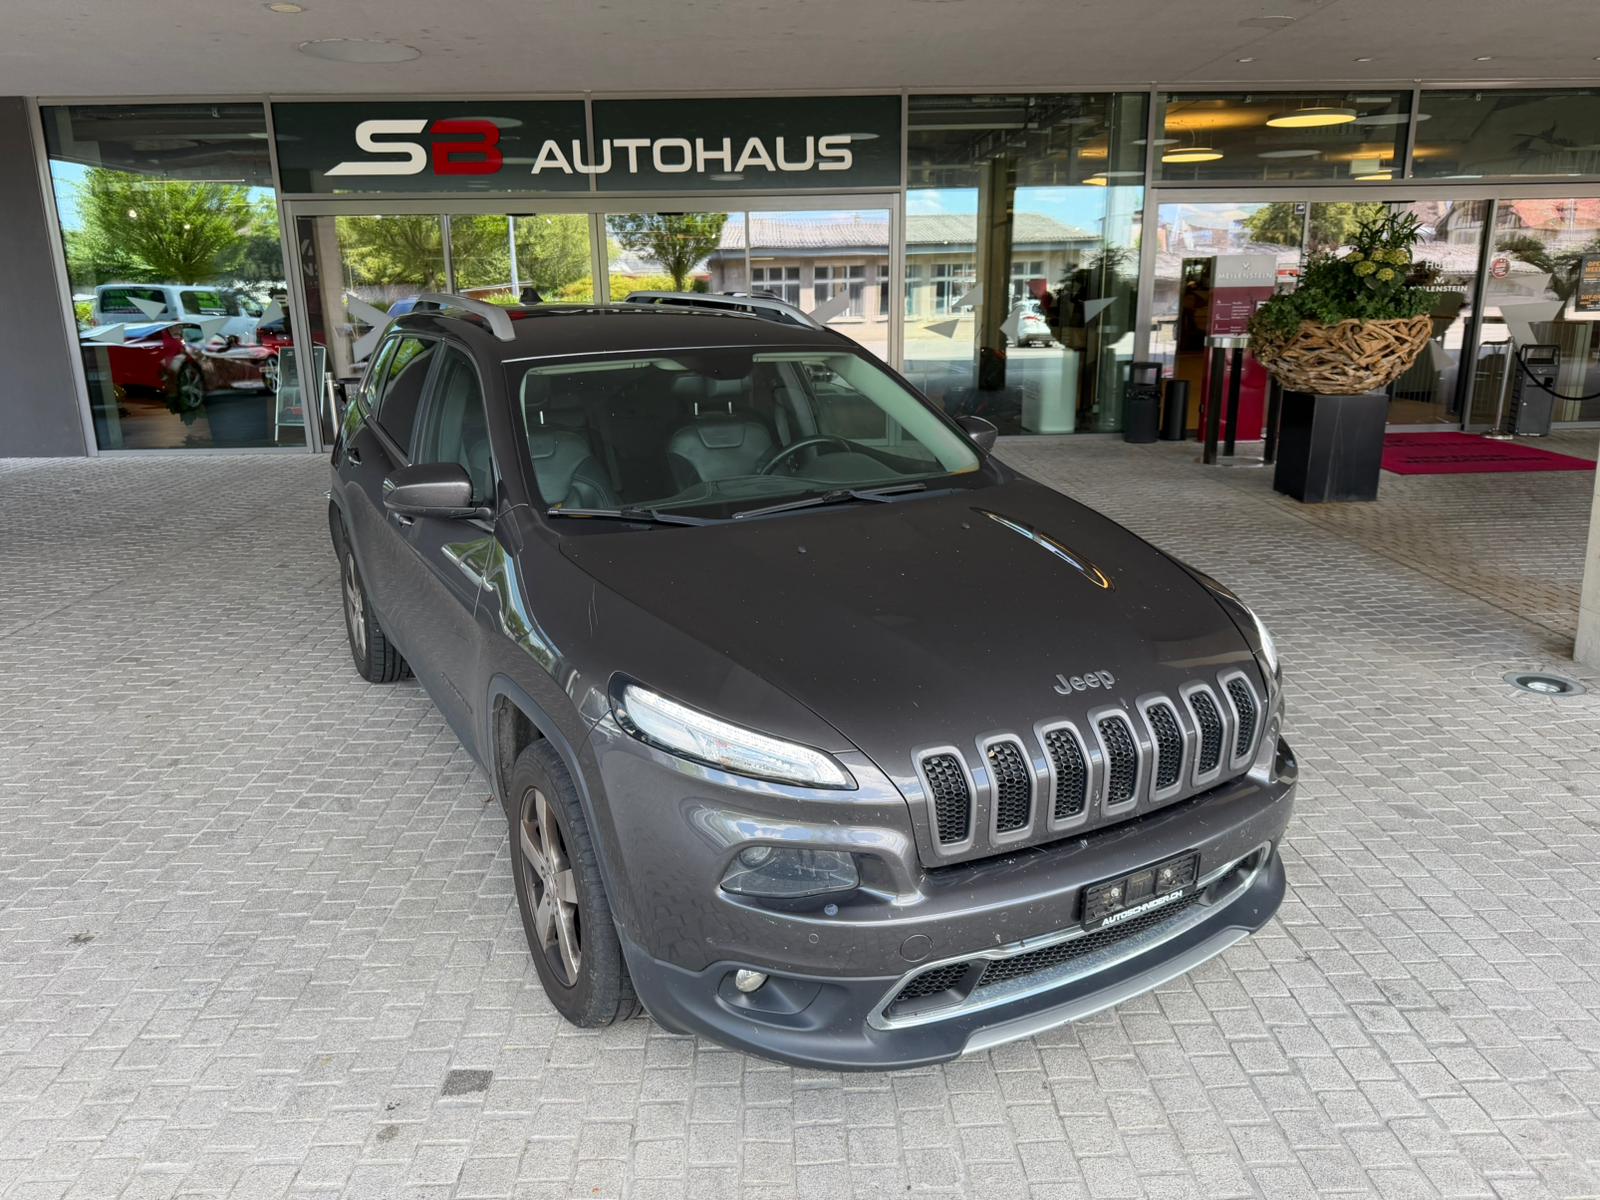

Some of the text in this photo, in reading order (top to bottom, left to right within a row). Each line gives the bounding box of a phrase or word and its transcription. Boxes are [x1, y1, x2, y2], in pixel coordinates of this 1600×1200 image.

[323, 119, 853, 176] SB AUTOHAUS
[1053, 669, 1115, 695] Jeep
